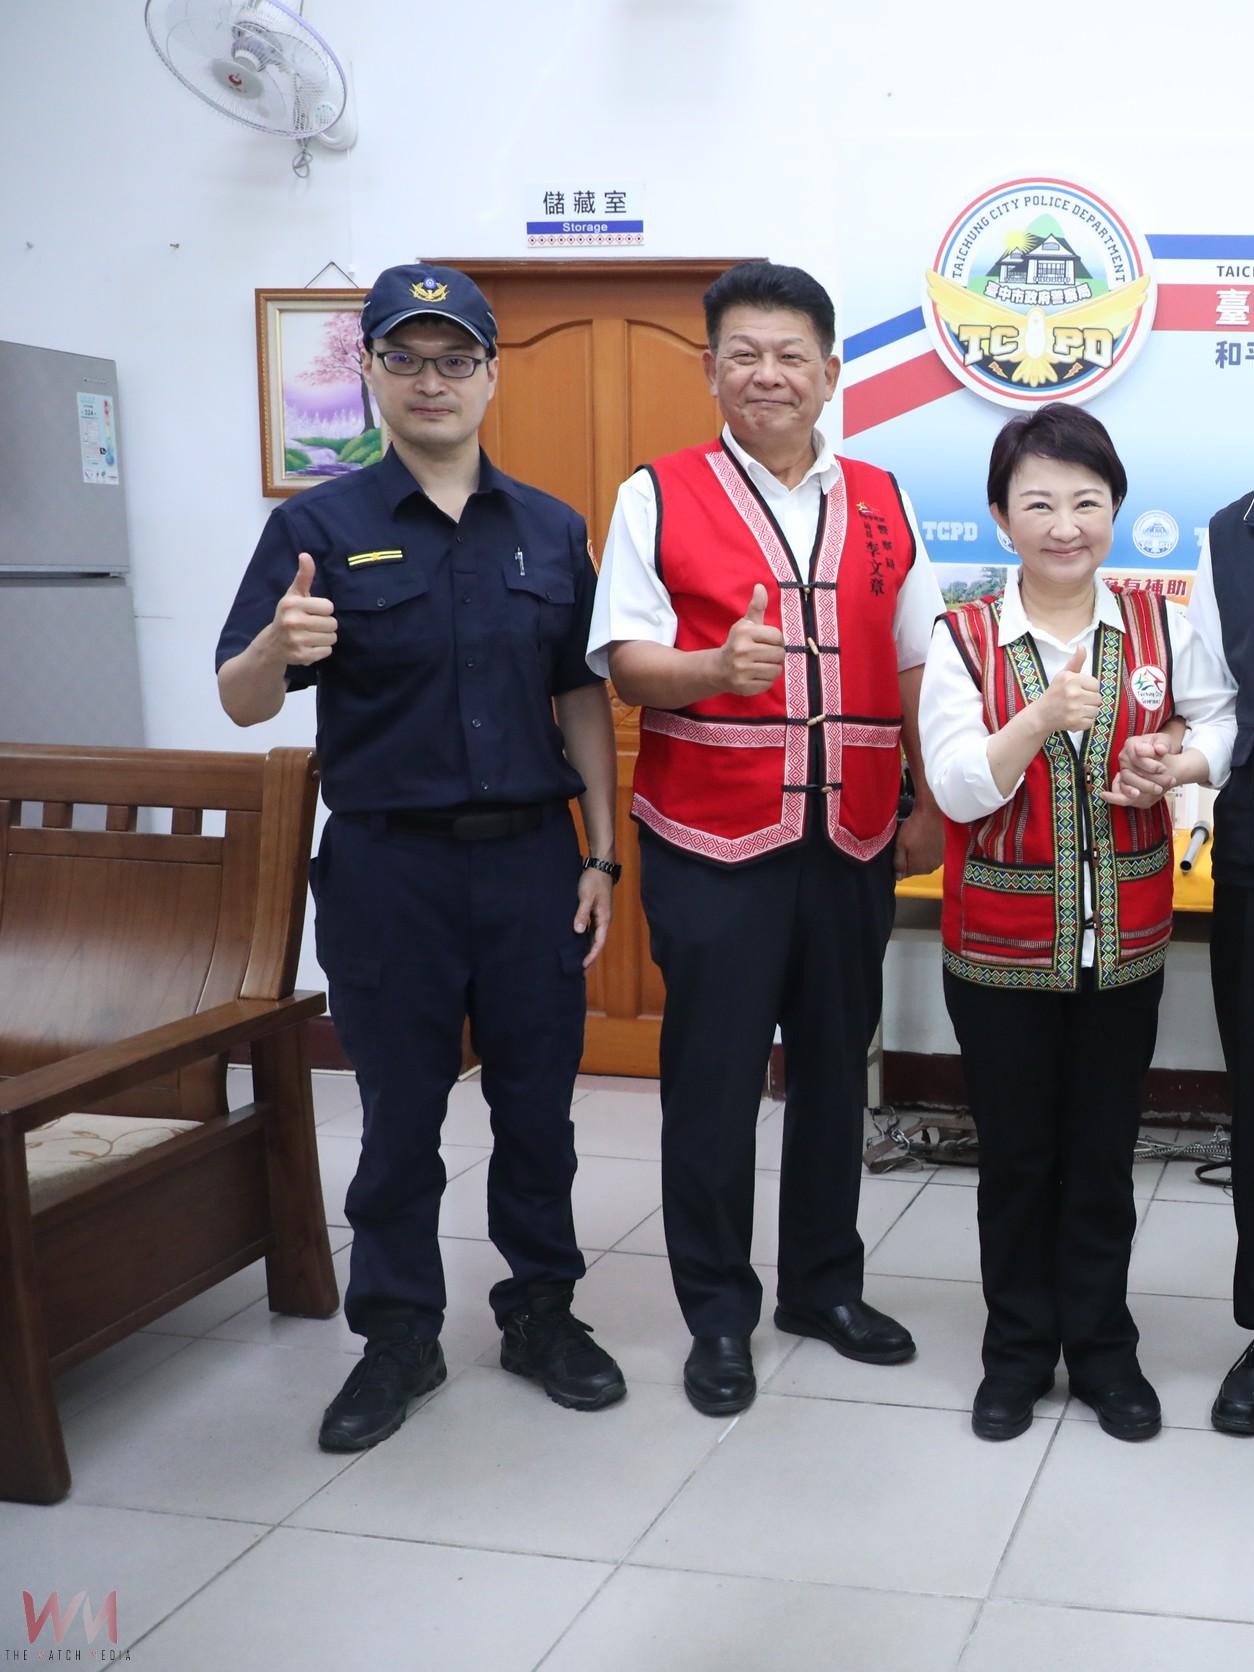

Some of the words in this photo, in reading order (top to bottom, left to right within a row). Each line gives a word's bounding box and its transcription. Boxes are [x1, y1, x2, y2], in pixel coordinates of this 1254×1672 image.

[543, 190, 627, 215] 儲藏室
[562, 222, 608, 233] Storage
[952, 216, 991, 279] TAICHUNG
[989, 198, 1019, 220] CITY
[1024, 195, 1071, 211] POLICE
[1072, 204, 1126, 282] DEPARTMENT
[984, 280, 1092, 306] 臺中市政府警察局
[922, 521, 978, 542] TCPD
